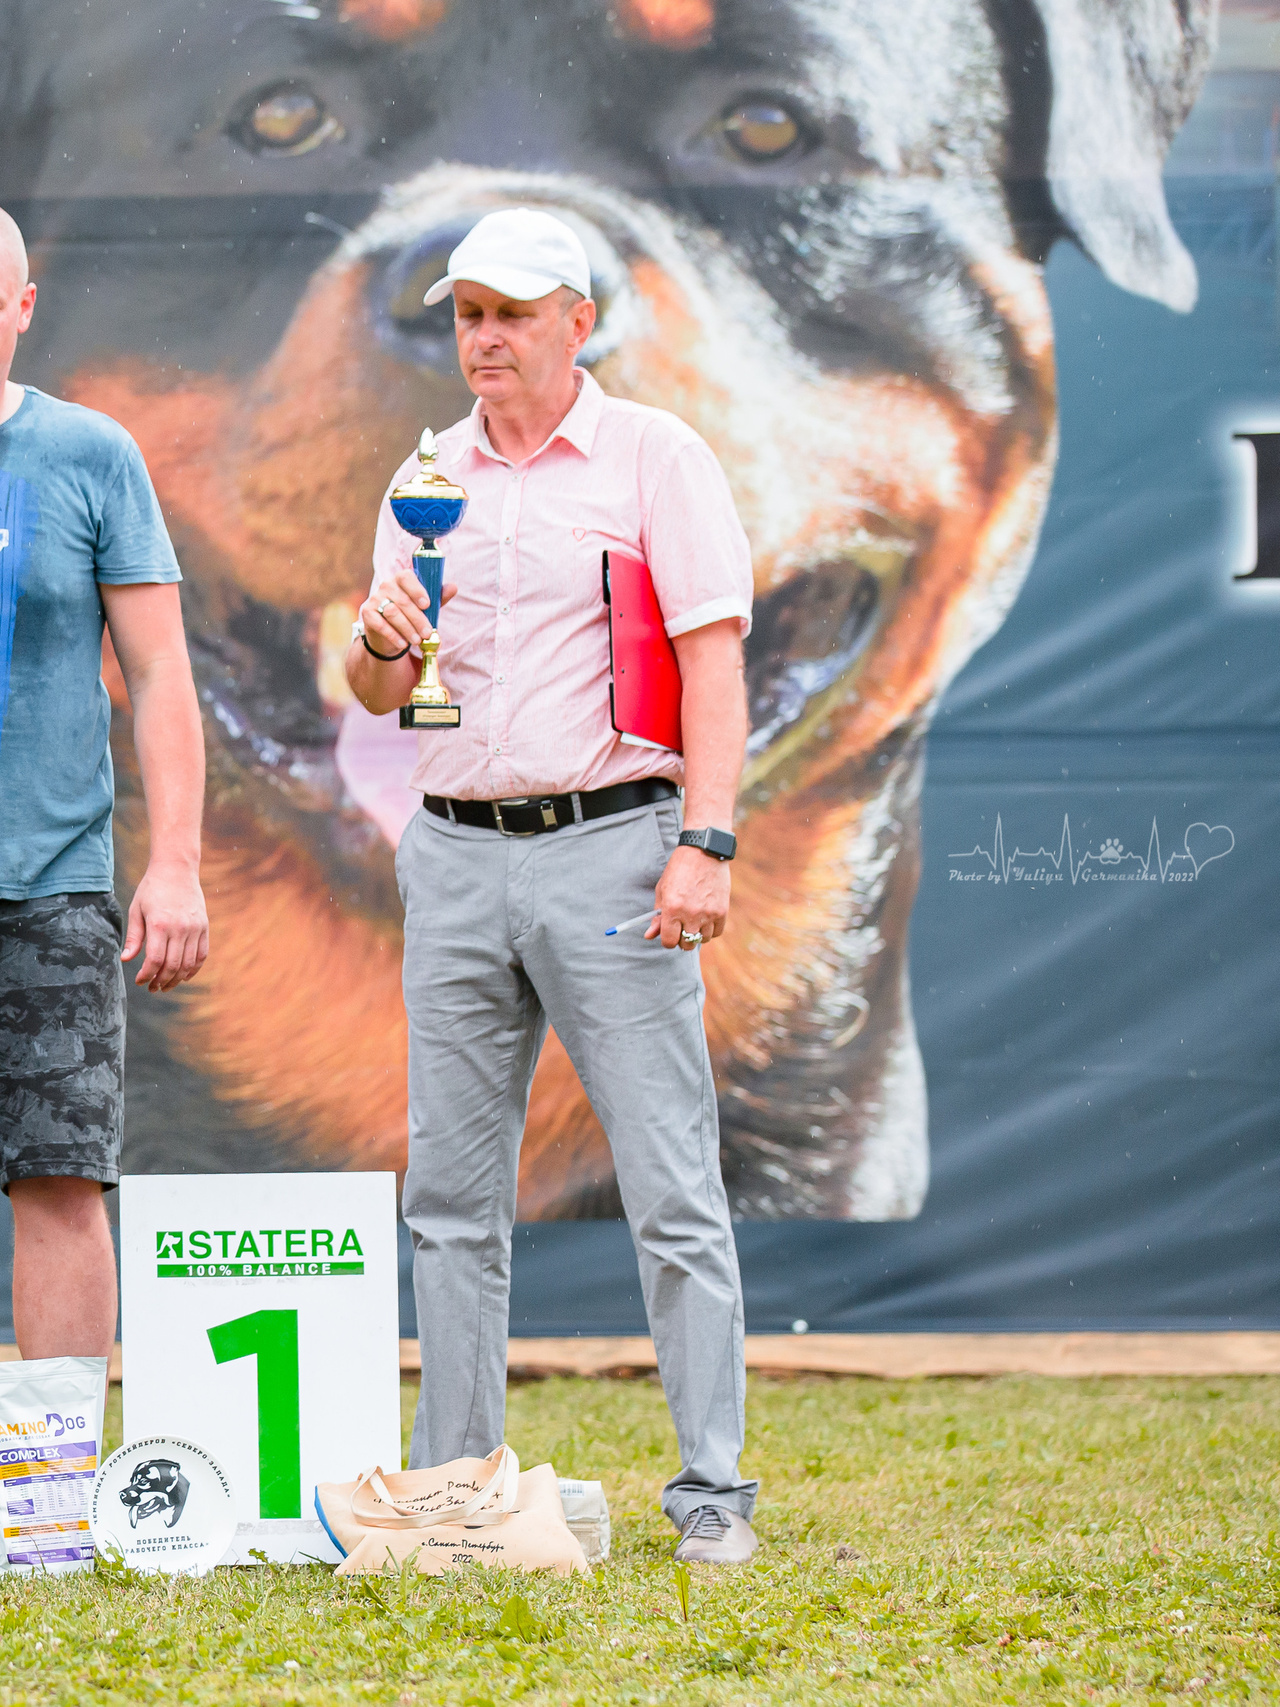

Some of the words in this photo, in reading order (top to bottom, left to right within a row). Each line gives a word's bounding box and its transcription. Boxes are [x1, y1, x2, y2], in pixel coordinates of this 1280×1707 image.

[189, 1229, 364, 1259] STATERA
[186, 1264, 232, 1277] 100%
[242, 1263, 332, 1276] BALANCE
[206, 1309, 301, 1519] 1
[0, 1447, 61, 1463] COMPLEX
[108, 1438, 166, 1468] РОТВЕЙЛЕРОВ
[136, 1535, 191, 1545] ПОБЕДИТЕЛЬ
